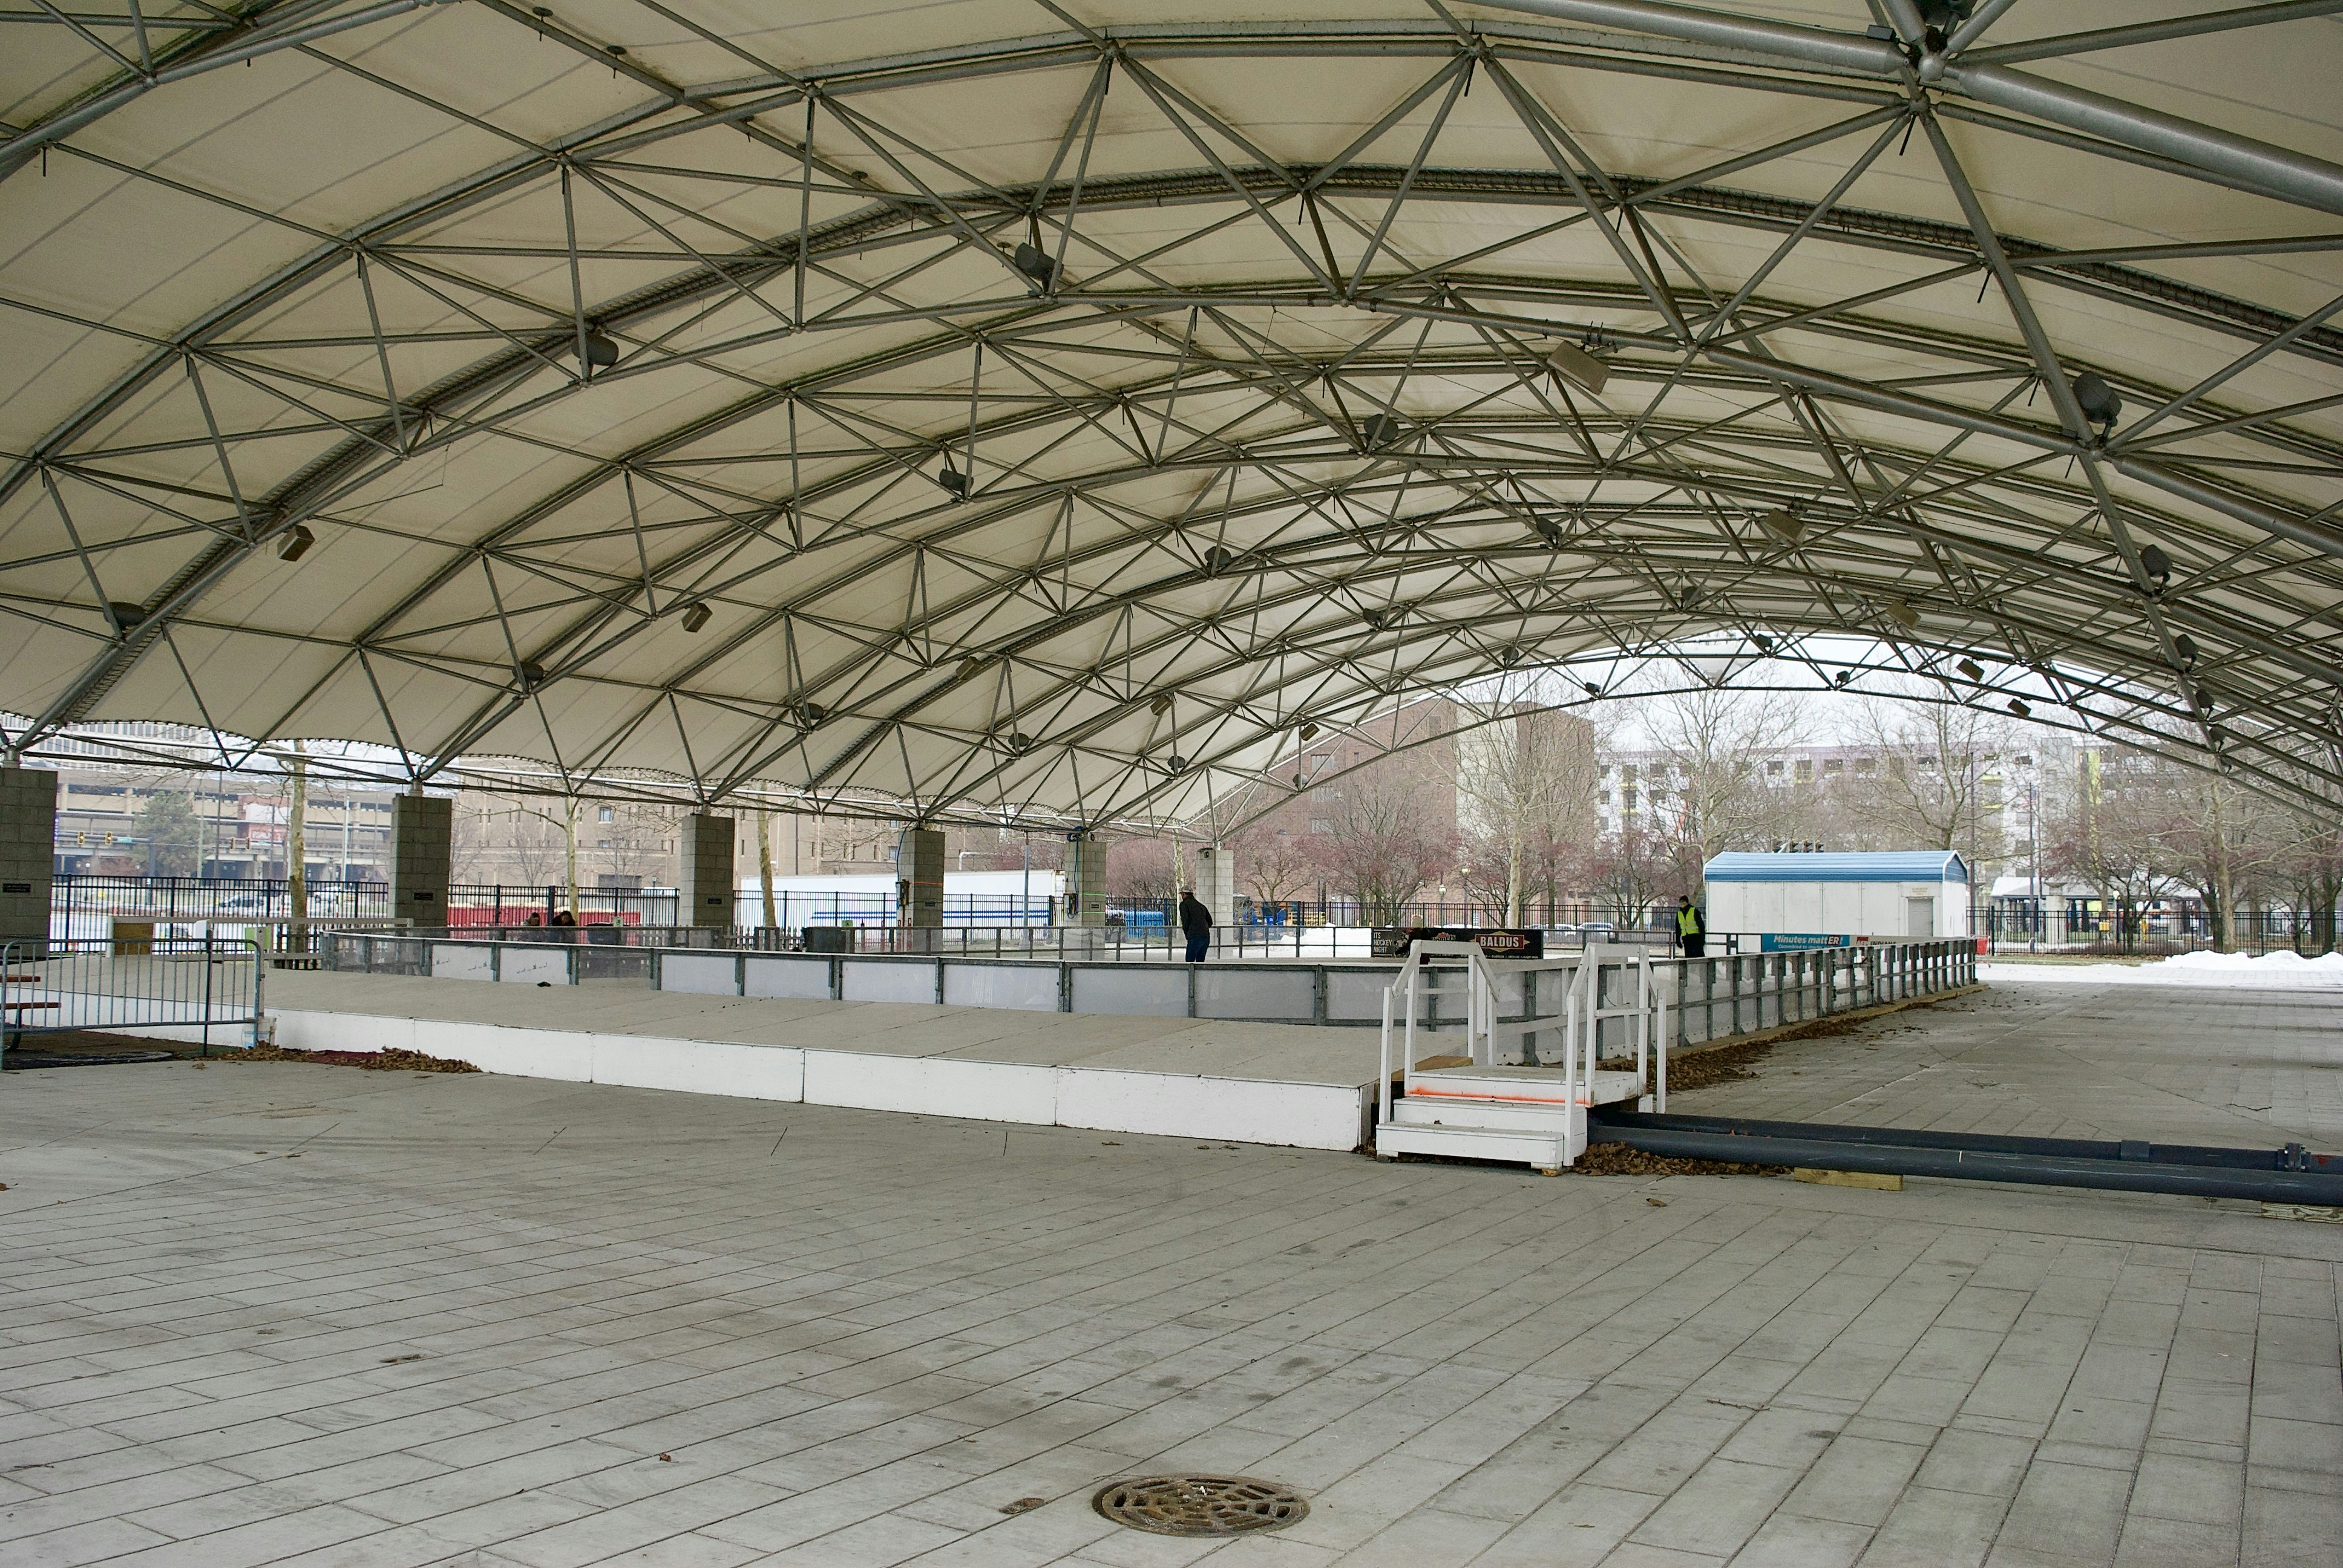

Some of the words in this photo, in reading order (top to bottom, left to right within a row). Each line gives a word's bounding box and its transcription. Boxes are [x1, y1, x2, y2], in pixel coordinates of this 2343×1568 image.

[1480, 936, 1519, 947] BALDUS
[1774, 935, 1806, 944] Minutes
[1808, 936, 1844, 945] mattER!
